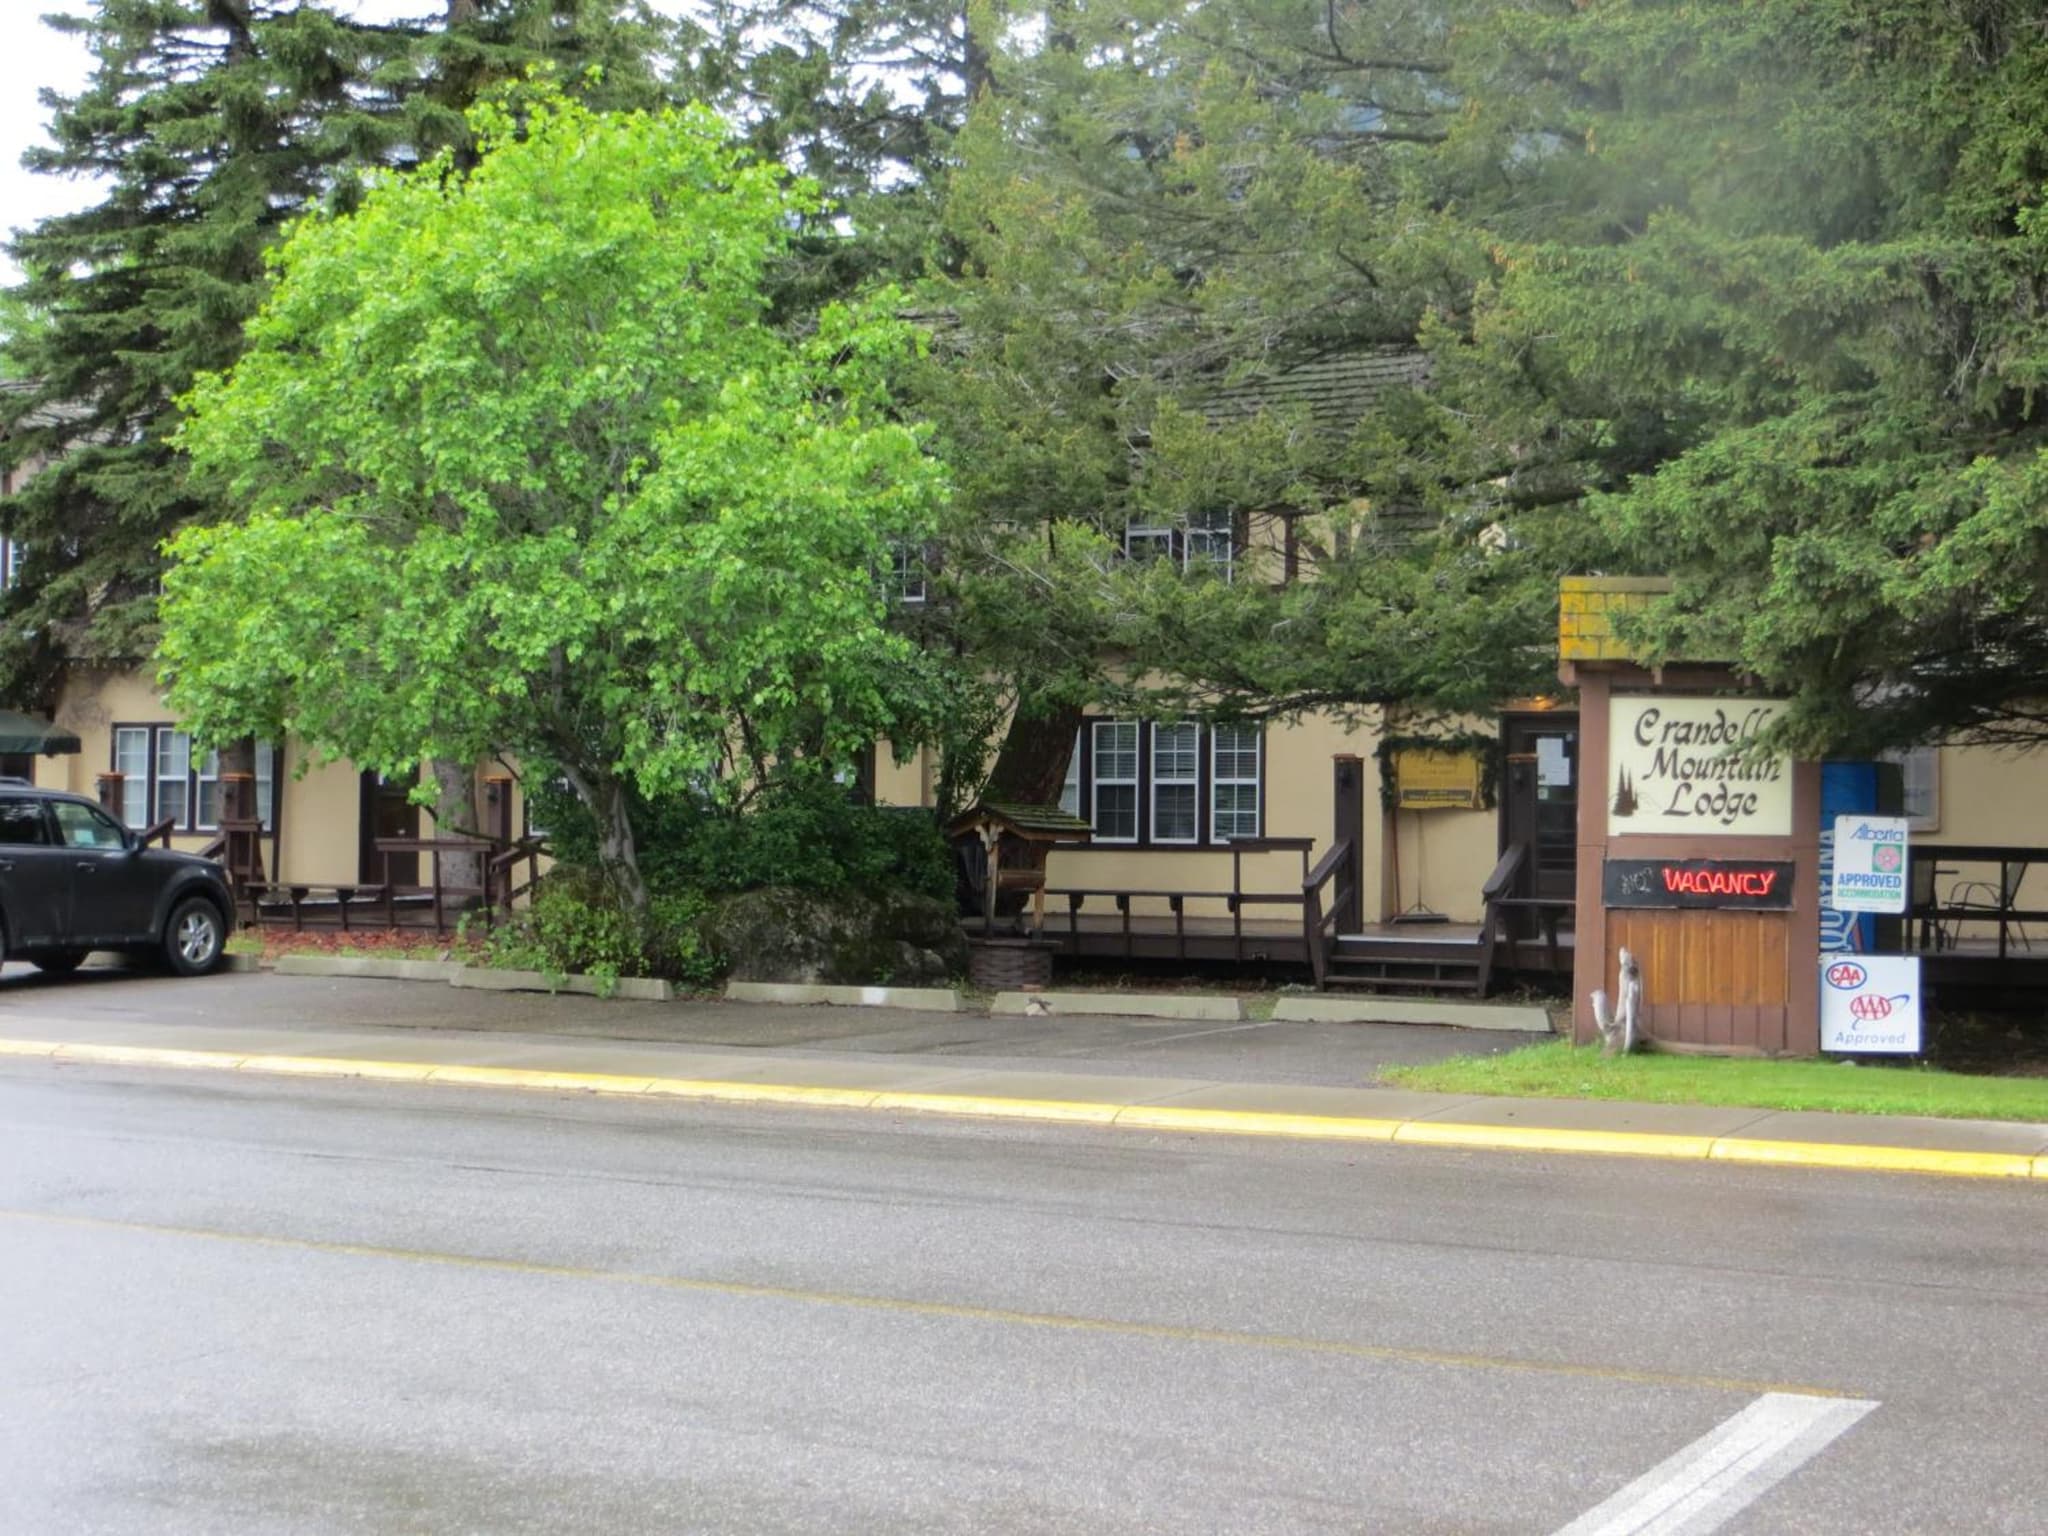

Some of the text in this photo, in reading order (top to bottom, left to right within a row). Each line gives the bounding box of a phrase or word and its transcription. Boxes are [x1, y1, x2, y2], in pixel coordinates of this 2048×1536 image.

[1634, 707, 1773, 747] Crandell
[1642, 746, 1781, 782] Mountain
[1662, 782, 1758, 825] Lodge
[1849, 823, 1904, 841] Alberta
[1662, 867, 1776, 895] VACANCY
[1838, 873, 1902, 889] APPROVED
[1830, 965, 1861, 985] CAA
[1850, 995, 1891, 1020] AAA
[1835, 1031, 1906, 1045] Approved
